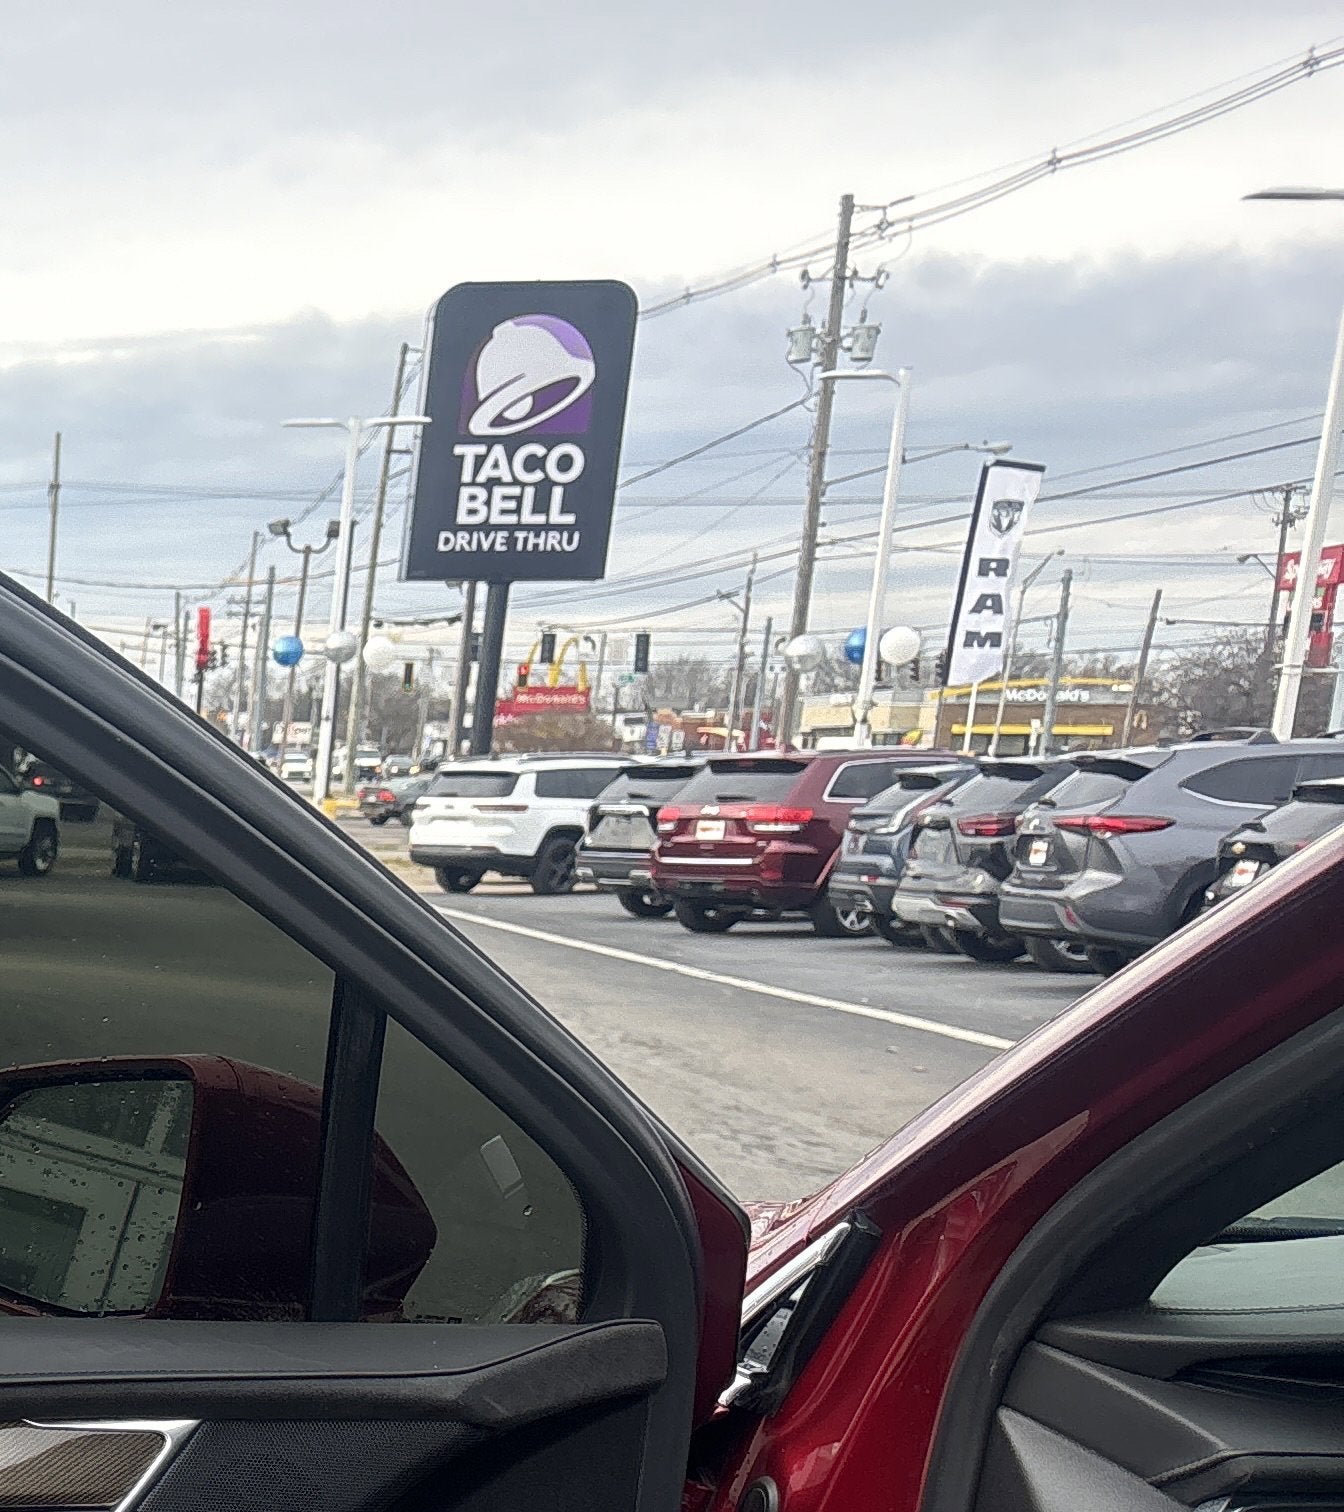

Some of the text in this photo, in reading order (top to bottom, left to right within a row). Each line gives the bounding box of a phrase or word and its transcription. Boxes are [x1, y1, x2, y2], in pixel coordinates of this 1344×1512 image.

[452, 443, 585, 484] TACO
[455, 485, 577, 525] BELL
[436, 530, 580, 552] DRIVE THRU
[962, 557, 1010, 648] RAM
[1005, 688, 1090, 702] McDoald's
